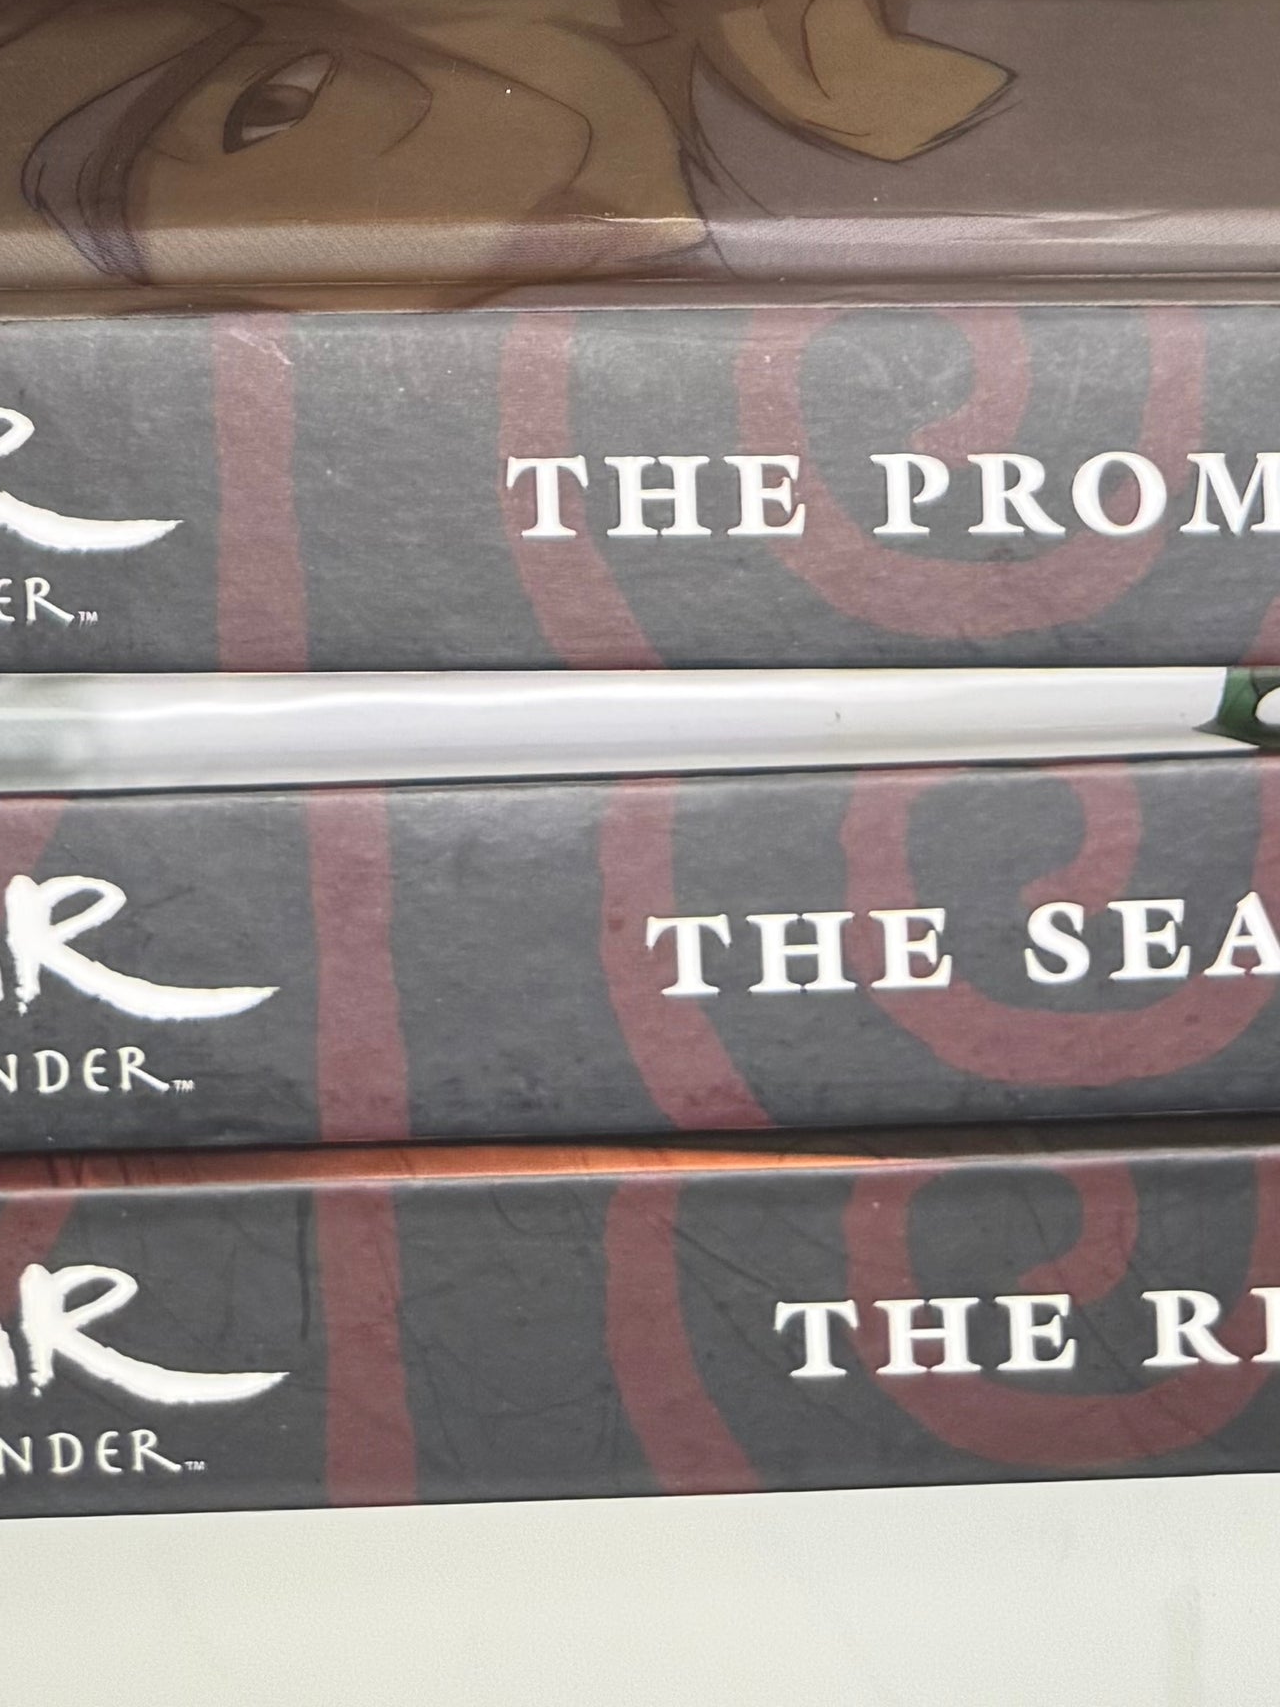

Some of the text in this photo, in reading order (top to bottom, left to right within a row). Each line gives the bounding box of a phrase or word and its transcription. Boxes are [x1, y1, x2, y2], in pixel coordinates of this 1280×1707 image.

[506, 454, 807, 539] THE
[644, 907, 953, 999] THE
[773, 1293, 1077, 1380] THE
